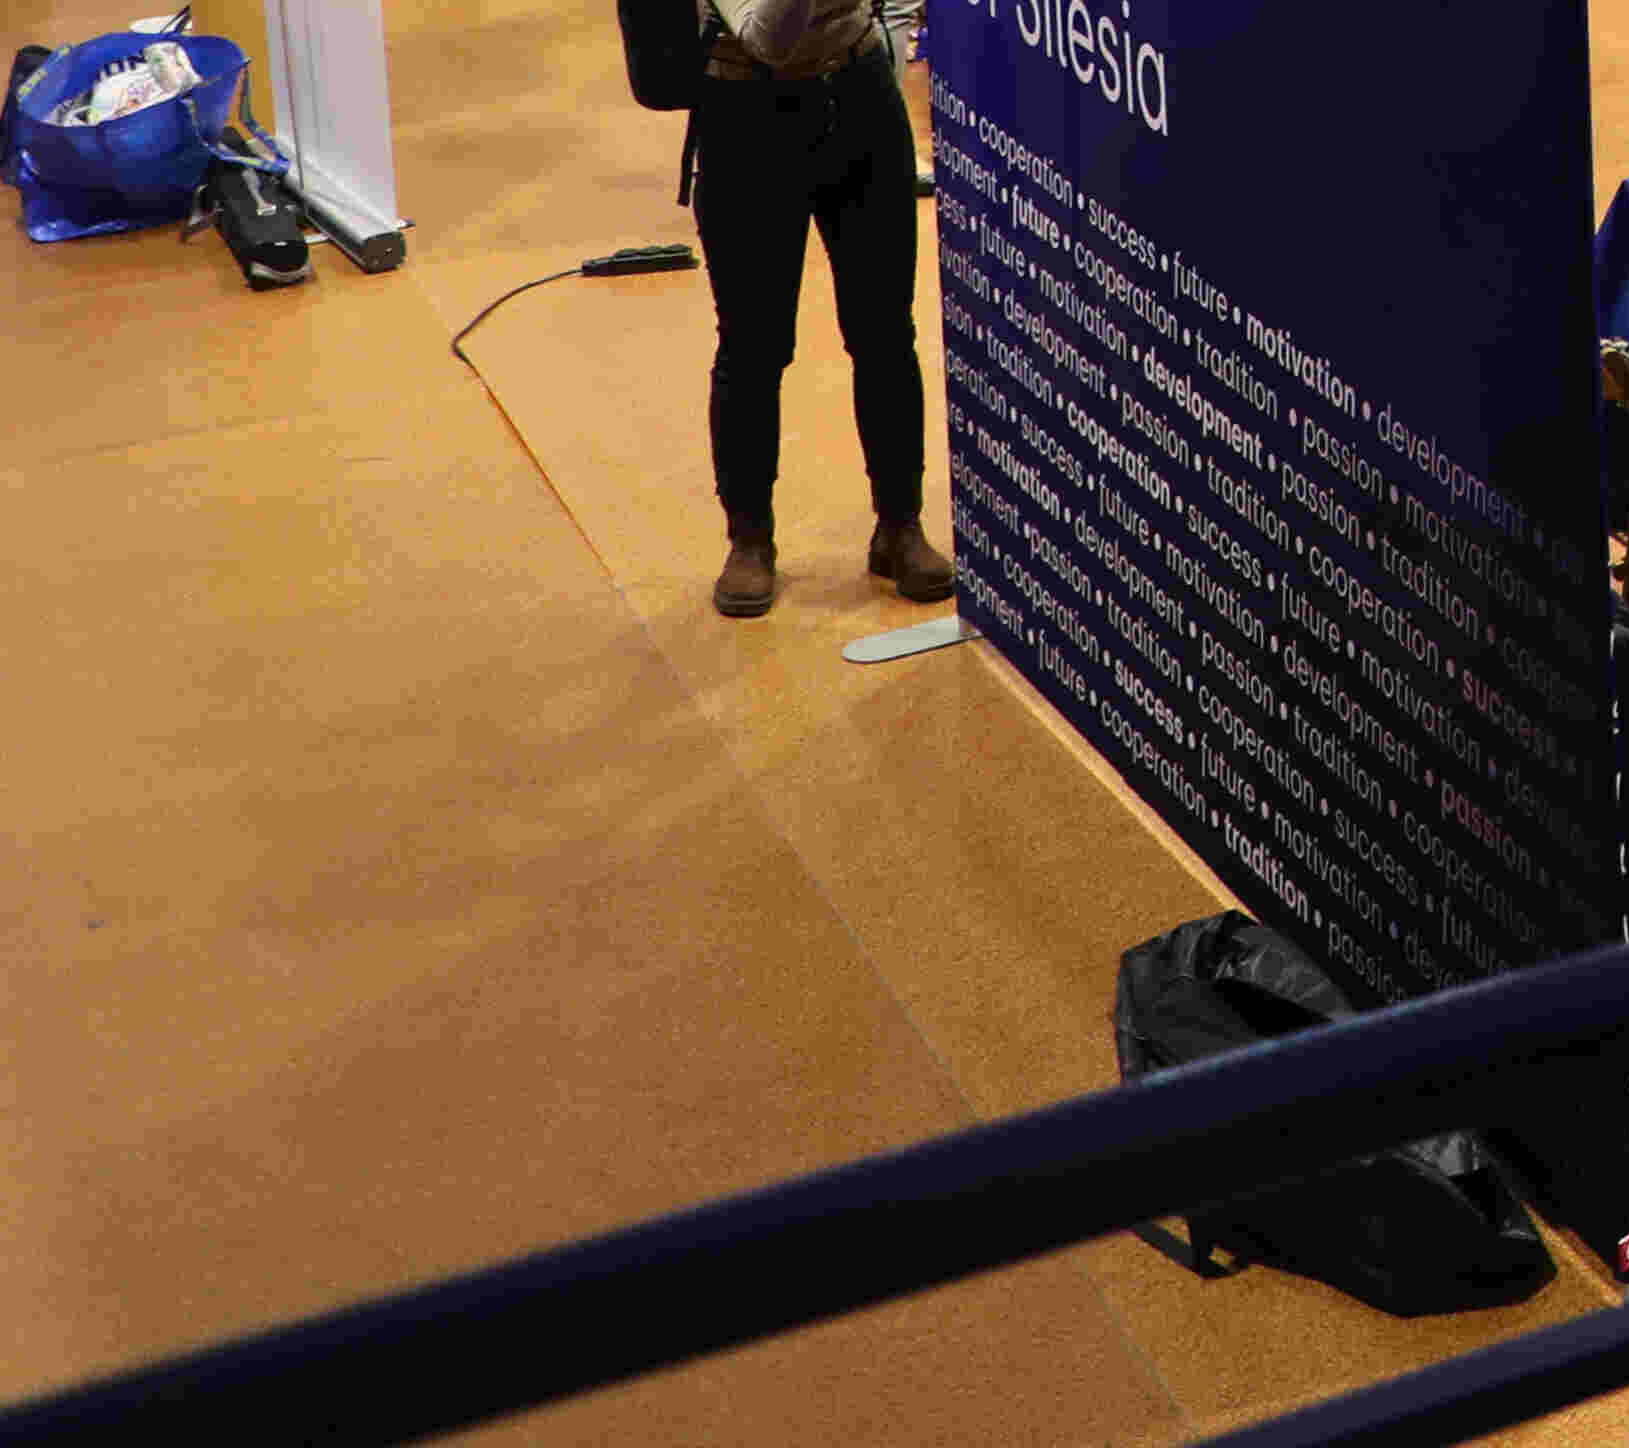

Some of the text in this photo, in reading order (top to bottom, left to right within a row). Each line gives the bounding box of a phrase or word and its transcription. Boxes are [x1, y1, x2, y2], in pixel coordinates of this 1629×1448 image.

[978, 114, 1356, 419] cooperation success future motivation
[980, 212, 1361, 550] future motivation development passion
[1011, 184, 1383, 502] future cooperation tradition passion
[986, 326, 1341, 654] tradition cooperation success future
[1004, 288, 1290, 550] development passion tradition
[1020, 412, 1265, 649] success future motivation
[977, 424, 1383, 813] motivation development passion tradition
[1002, 550, 1257, 813] cooperation success future
[1029, 526, 1317, 814] passion tradition cooperation
[1037, 628, 1310, 924] future cooperation tradition
